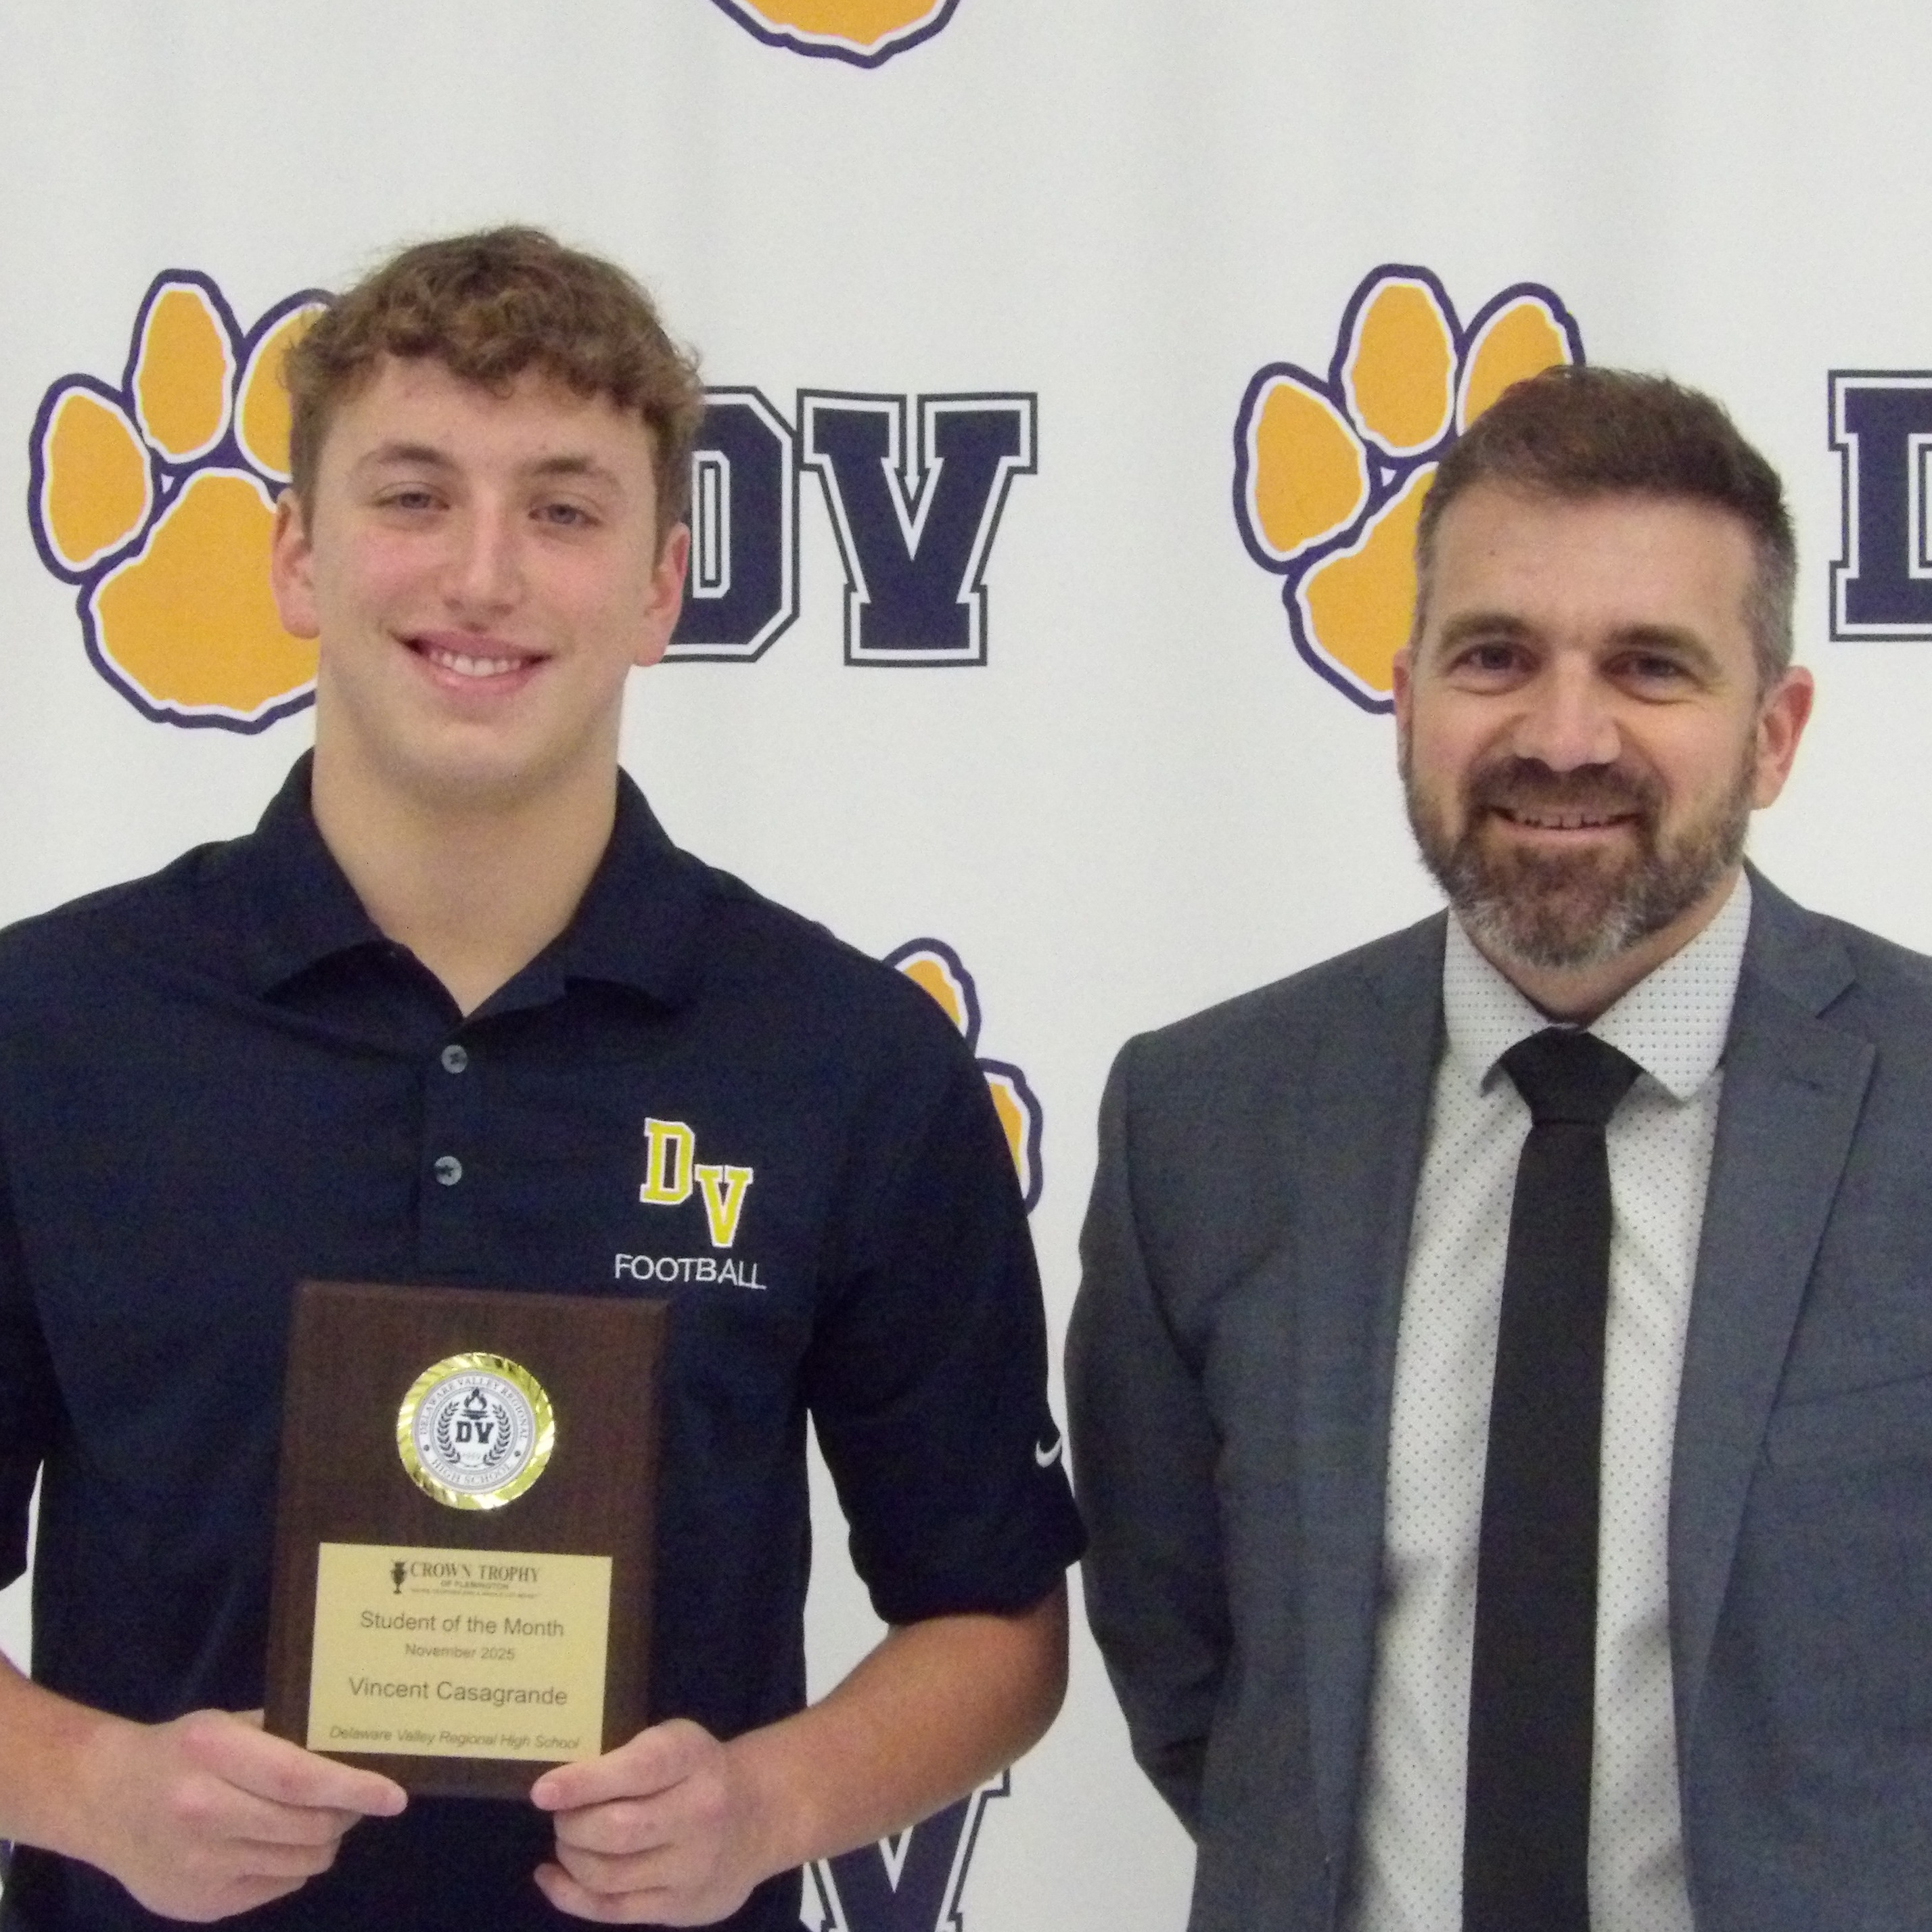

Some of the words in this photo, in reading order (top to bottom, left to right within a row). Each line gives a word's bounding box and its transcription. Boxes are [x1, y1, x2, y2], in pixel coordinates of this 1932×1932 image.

[659, 386, 1038, 667] DV
[640, 1117, 754, 1248] DV
[615, 1254, 767, 1290] FOOTBALL
[458, 1377, 499, 1389] VALLEY
[455, 1421, 495, 1444] DV
[431, 1458, 461, 1483] HIGH
[410, 1562, 471, 1578] CROWN
[478, 1565, 540, 1582] TROPHY
[360, 1610, 436, 1632] Student
[442, 1615, 461, 1632] of
[467, 1615, 497, 1634] the
[503, 1617, 564, 1638] Month
[405, 1643, 476, 1659] November
[481, 1647, 516, 1660] 2025
[348, 1676, 430, 1699] Vincent
[436, 1681, 568, 1707] Casagrande
[329, 1726, 392, 1742] Delaware
[397, 1728, 436, 1746] Valley
[439, 1730, 496, 1747] Regional
[499, 1734, 531, 1750] High
[534, 1734, 581, 1749] School
